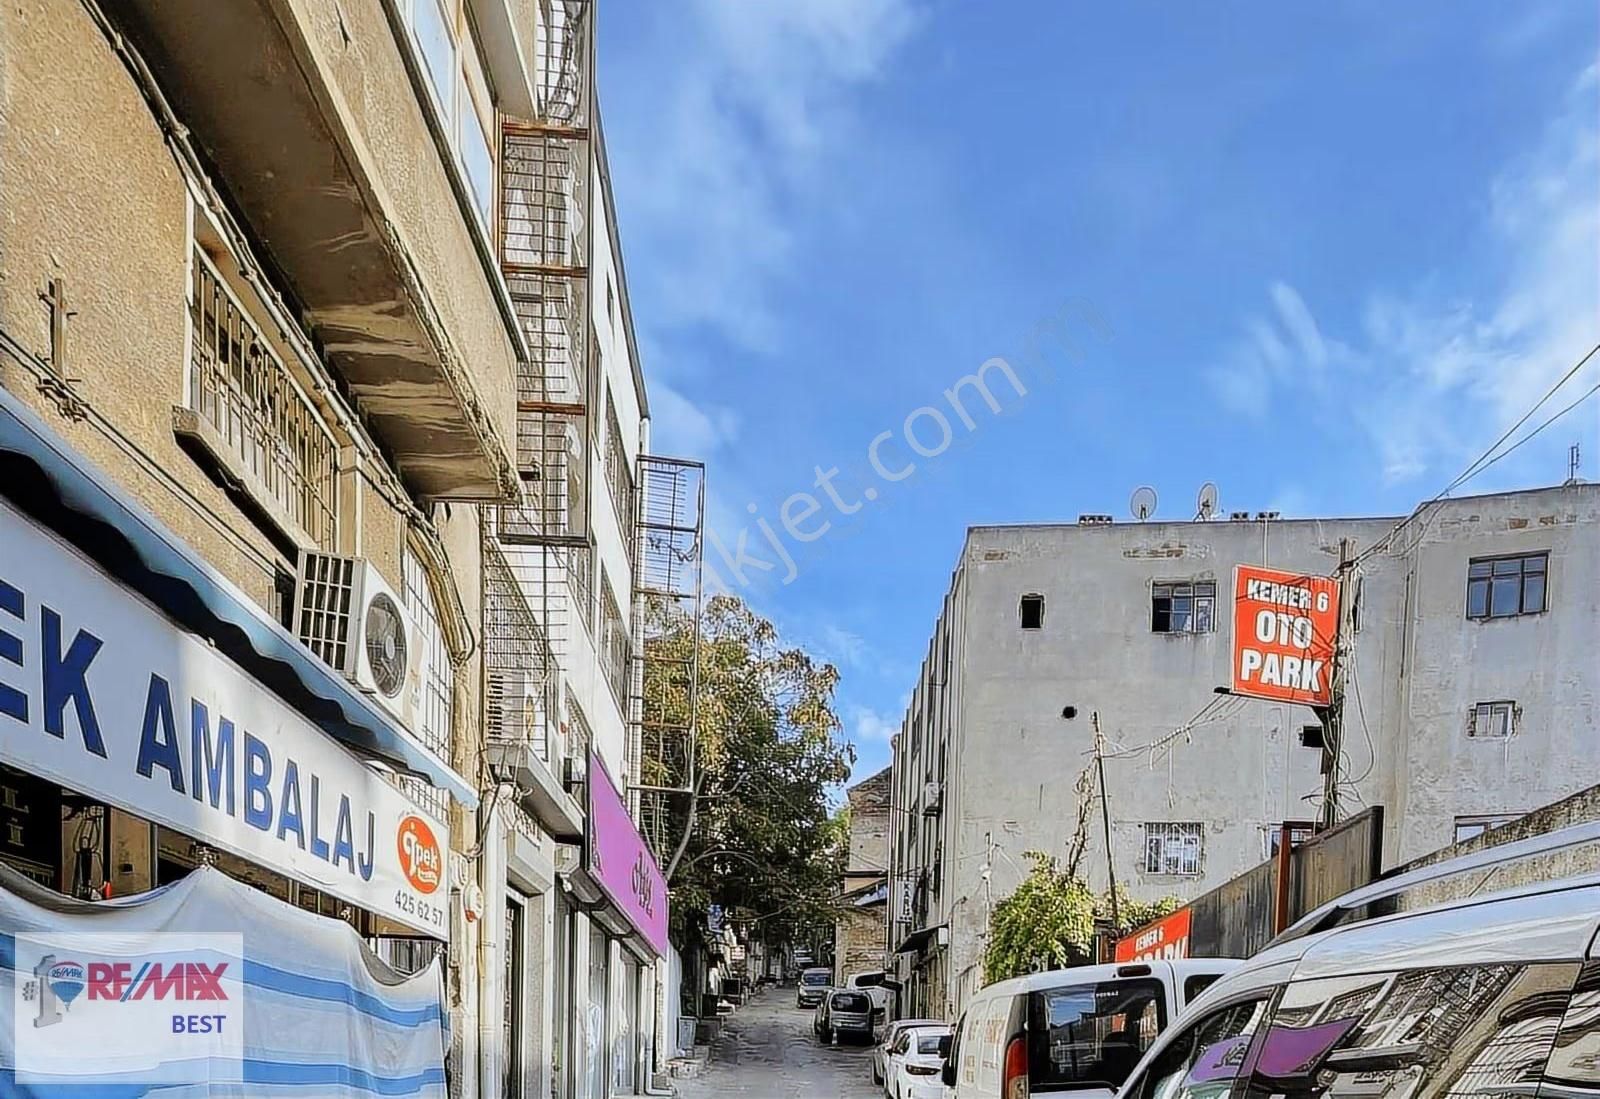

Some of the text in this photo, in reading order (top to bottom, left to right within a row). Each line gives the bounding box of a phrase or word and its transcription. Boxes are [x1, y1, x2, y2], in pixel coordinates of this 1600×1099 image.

[1246, 578, 1330, 612] KEMER 6
[1255, 610, 1313, 650] OTO
[1240, 648, 1324, 694] PARK
[136, 671, 375, 882] AMBALAJ
[394, 890, 444, 927] 425 62 57
